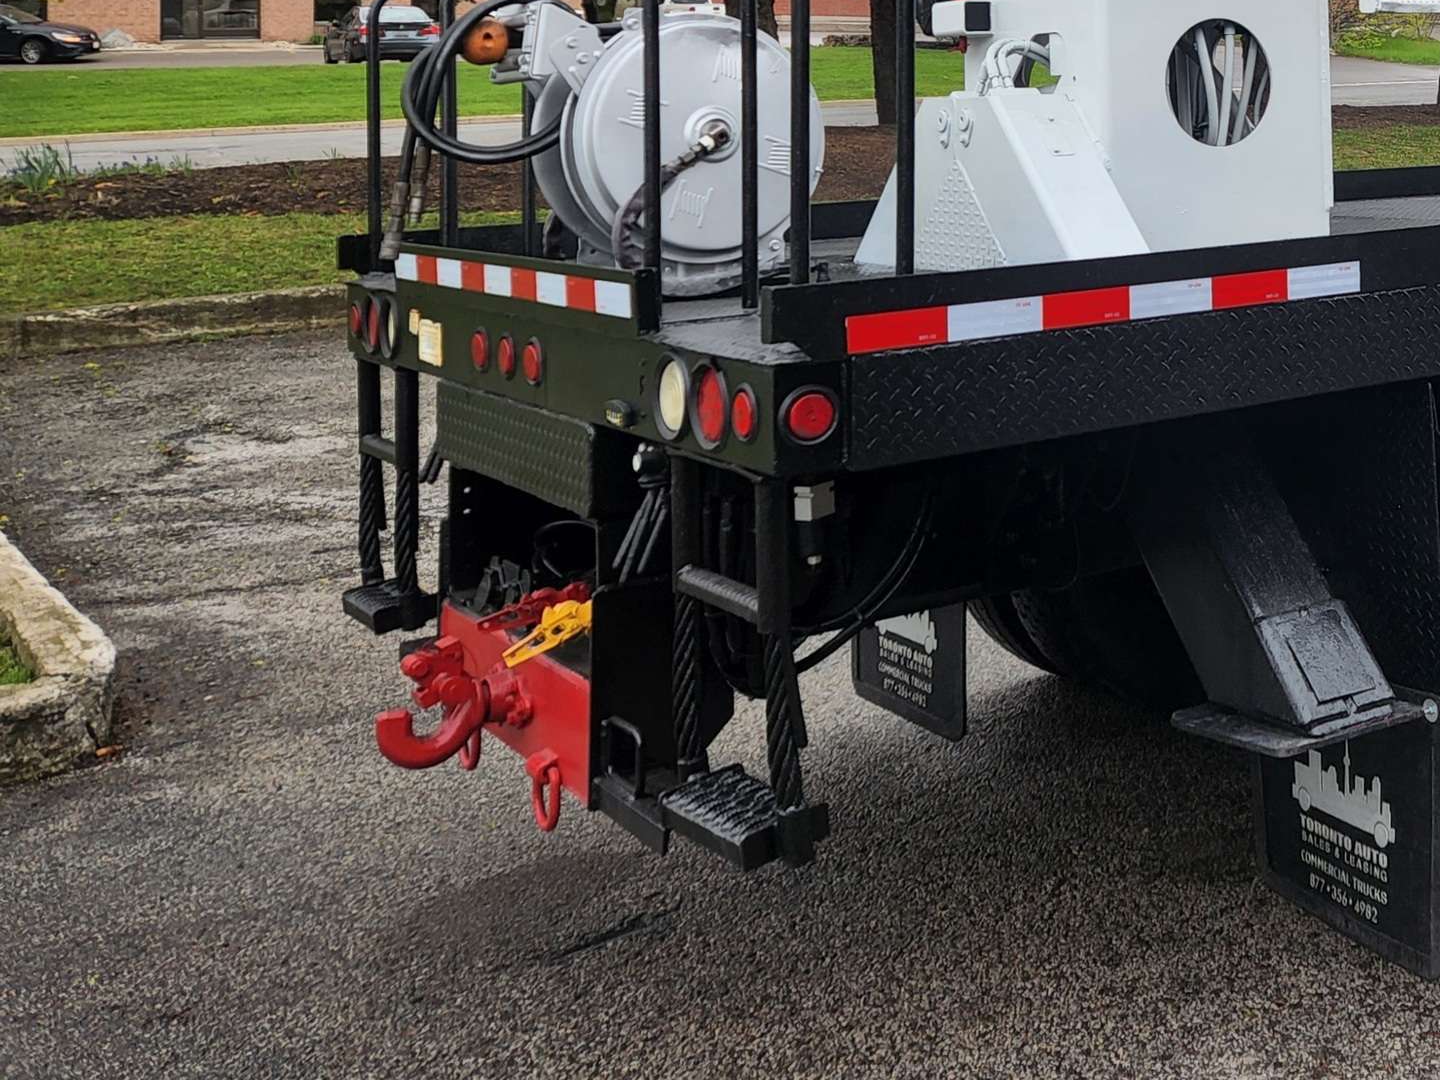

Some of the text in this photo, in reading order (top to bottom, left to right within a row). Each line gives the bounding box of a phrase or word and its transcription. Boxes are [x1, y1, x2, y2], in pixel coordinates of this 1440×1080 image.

[1300, 812, 1388, 869] TORONTO AUTO
[1302, 829, 1331, 853] SALES
[1344, 851, 1388, 883] LEASING
[1301, 849, 1388, 905] COMMERCIAL TRUCKS
